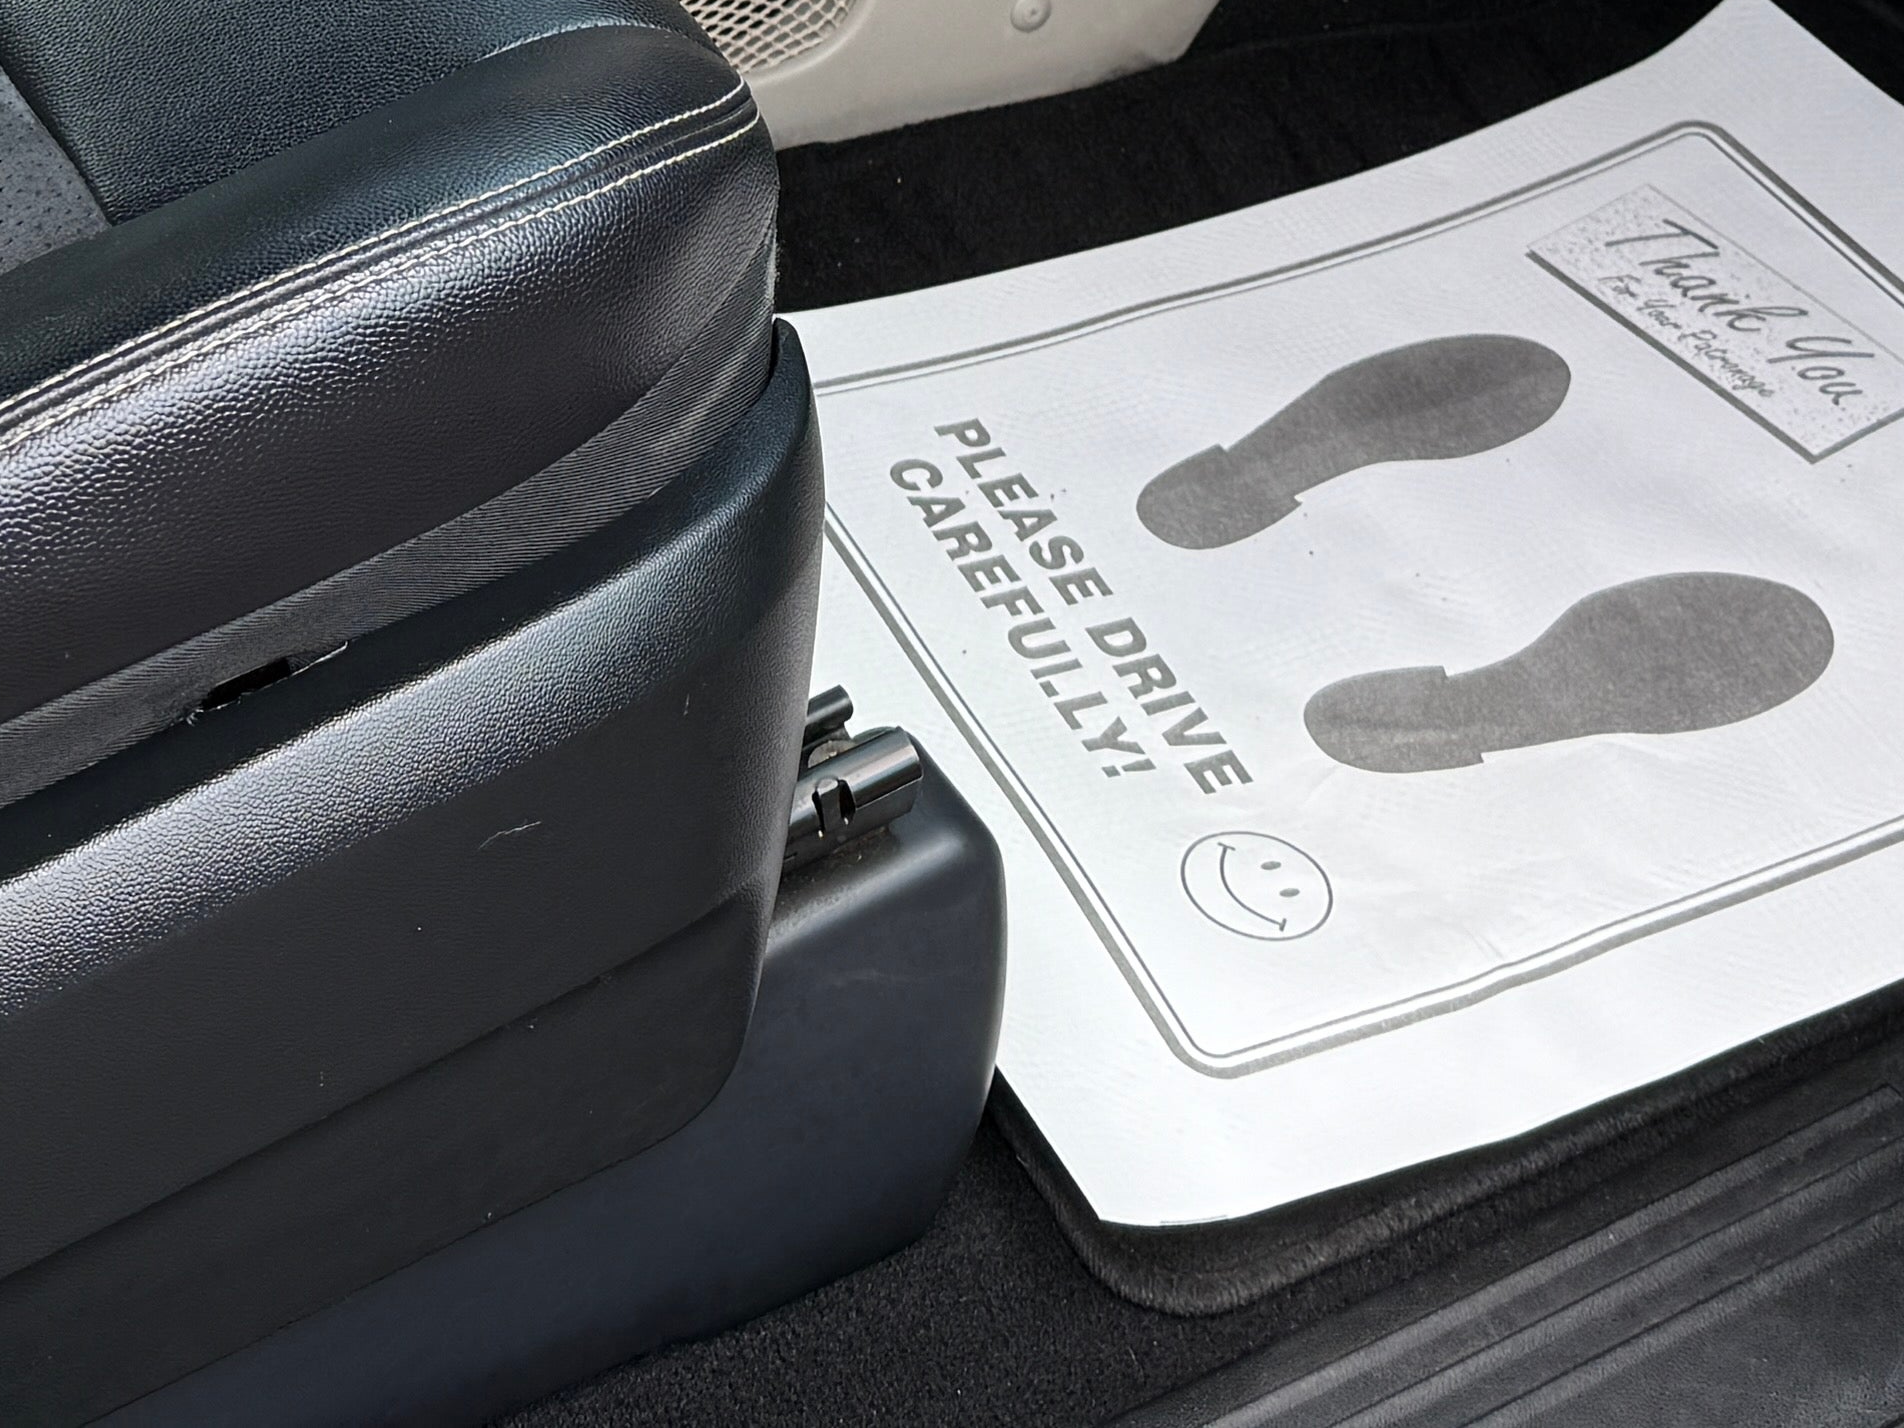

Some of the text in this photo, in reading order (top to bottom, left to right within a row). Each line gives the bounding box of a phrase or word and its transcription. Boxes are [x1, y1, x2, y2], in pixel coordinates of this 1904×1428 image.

[1599, 274, 1776, 400] For Your Patronage
[1604, 217, 1875, 406] Thank You
[889, 457, 1157, 779] CAREFULLY!
[934, 417, 1255, 795] PLEASE DRIVE
